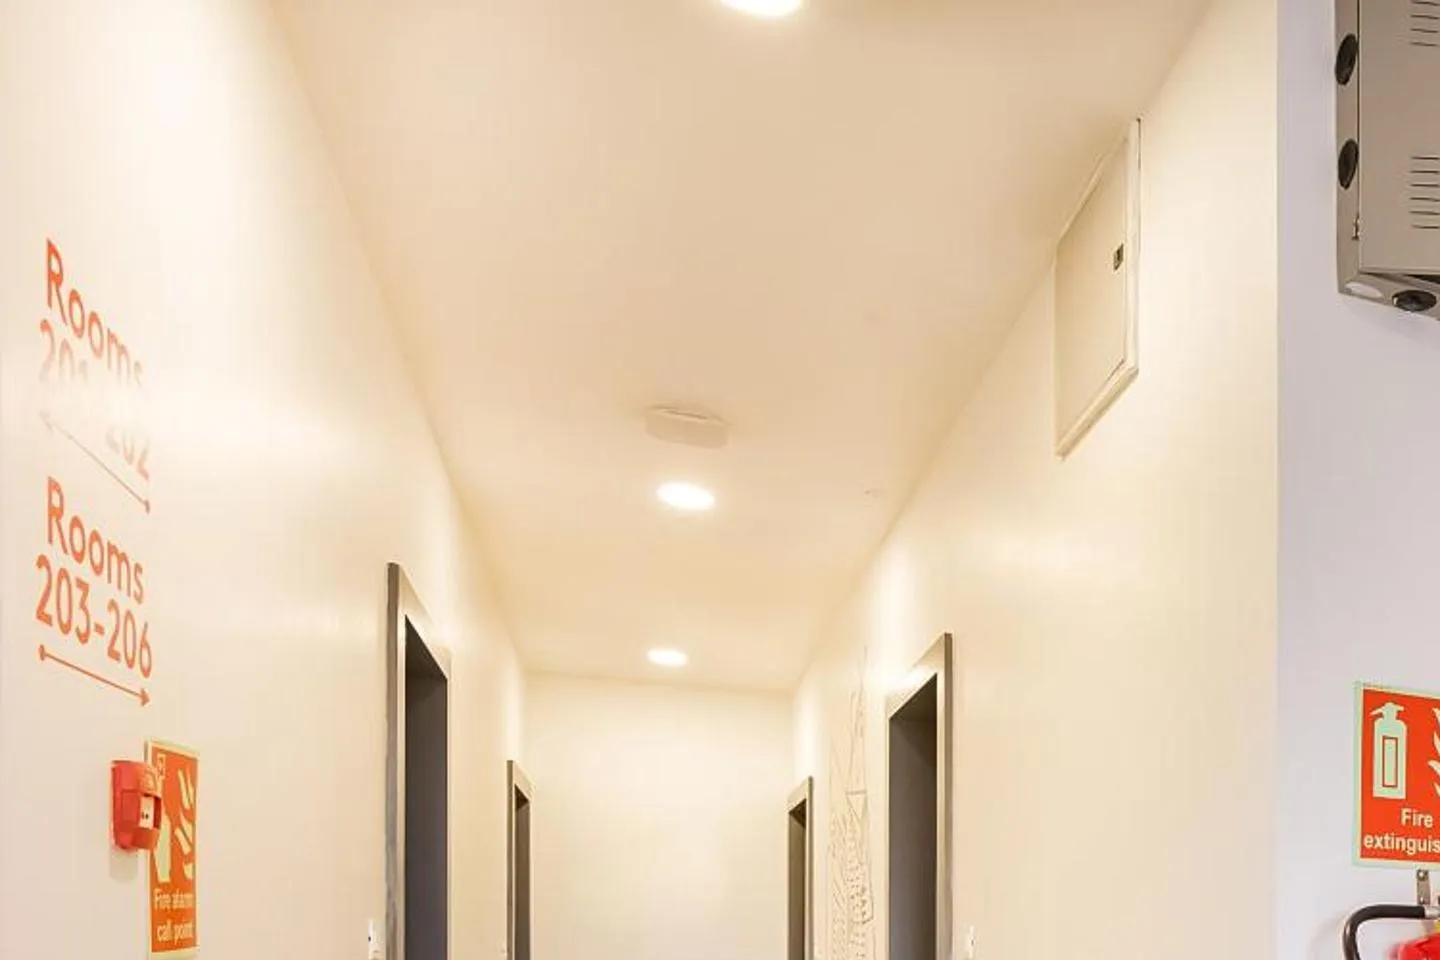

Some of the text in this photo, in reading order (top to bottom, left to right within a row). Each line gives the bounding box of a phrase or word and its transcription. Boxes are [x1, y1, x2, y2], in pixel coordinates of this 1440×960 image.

[47, 476, 145, 605] Rooms
[35, 554, 153, 679] 203-206
[1401, 808, 1434, 828] Fire
